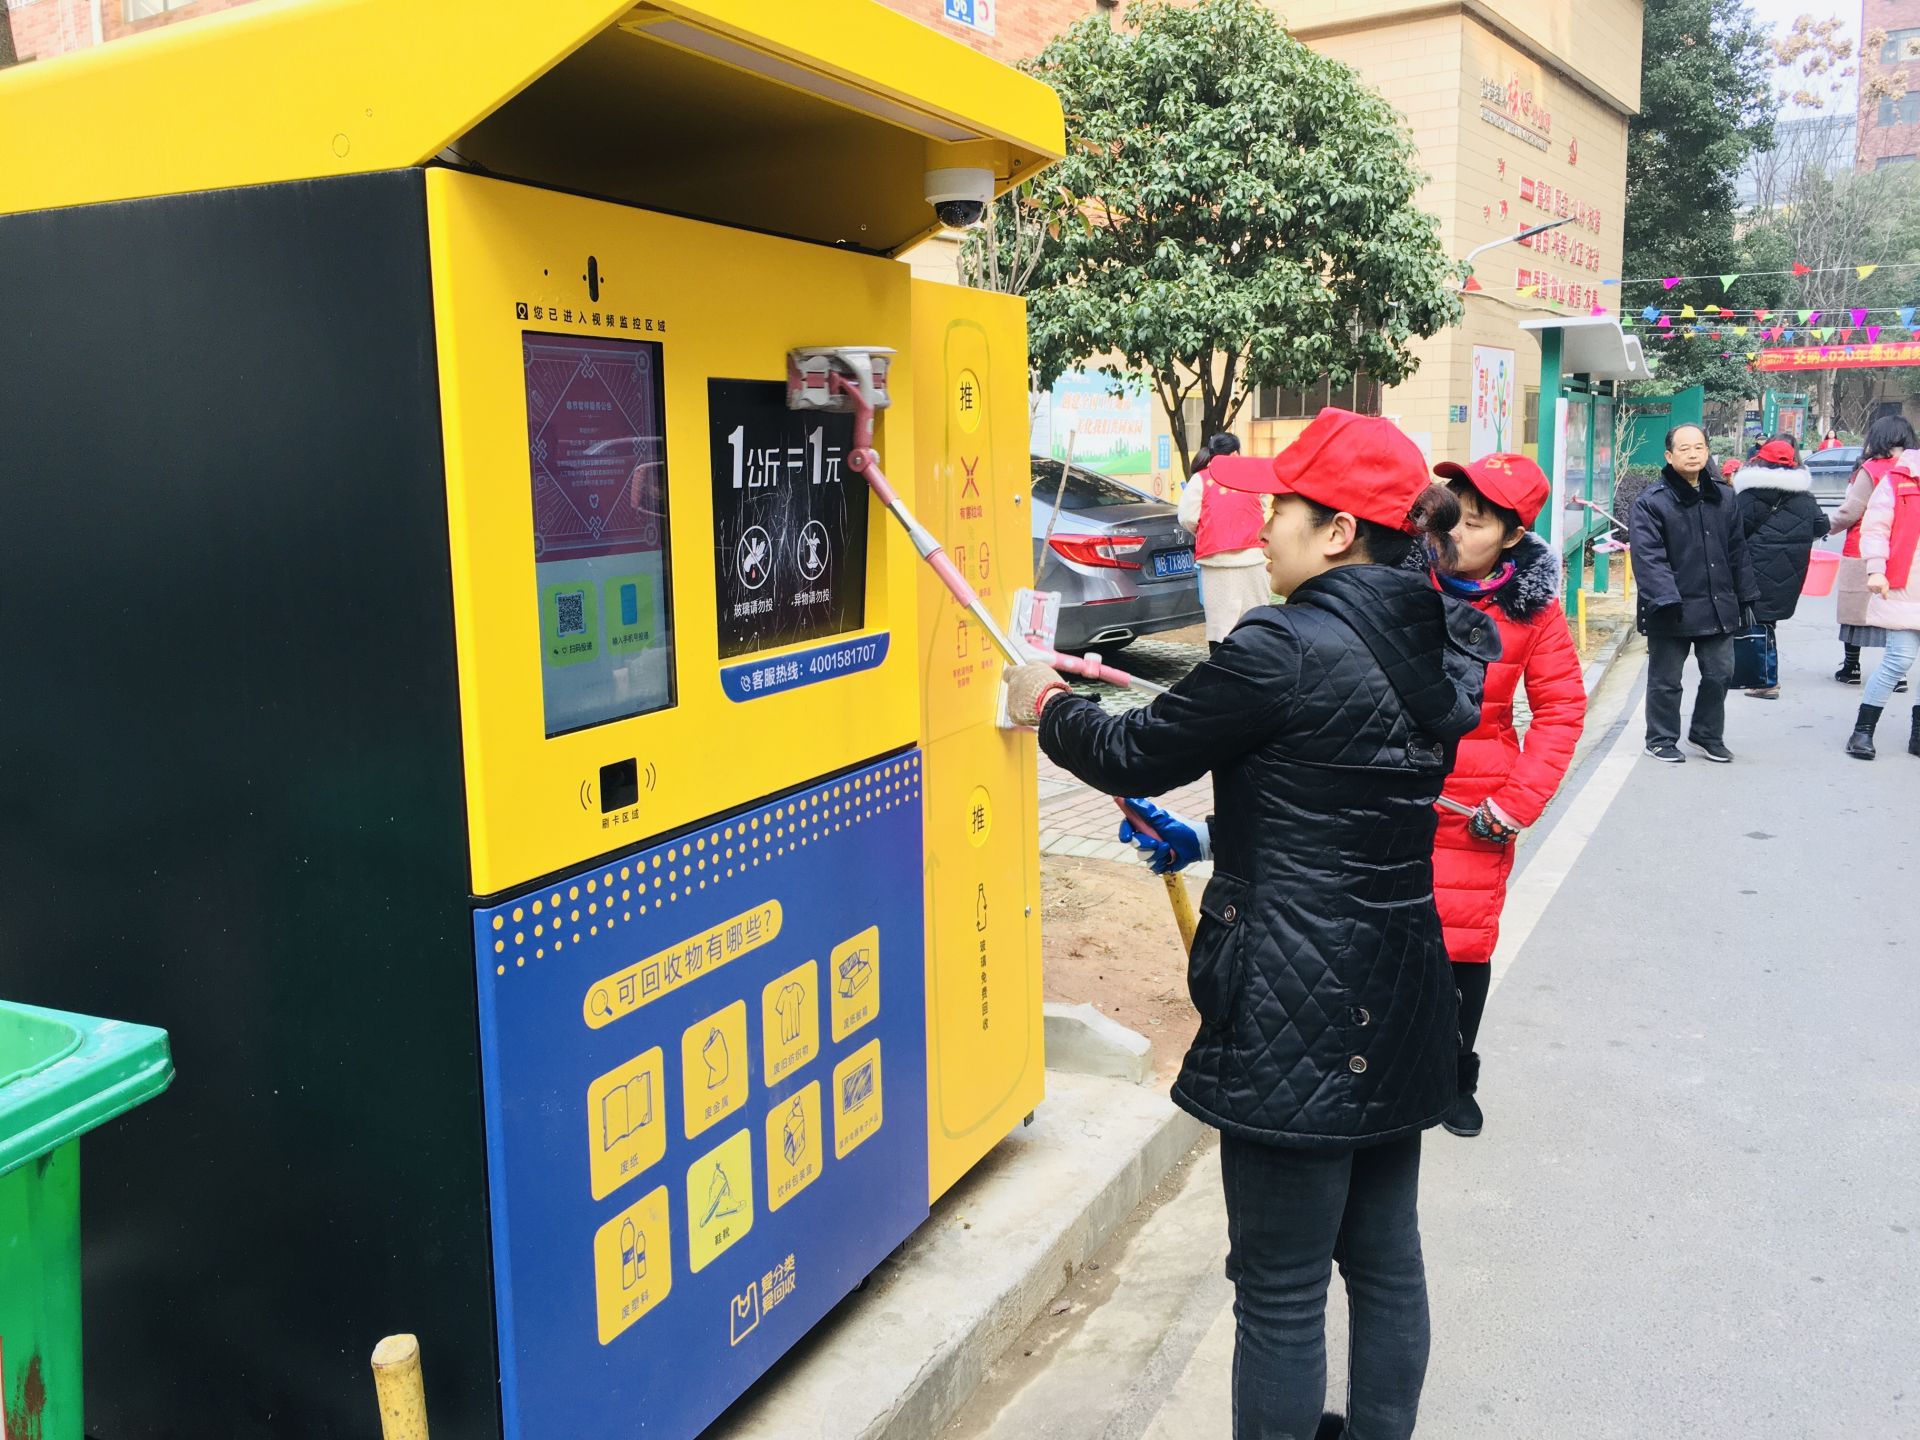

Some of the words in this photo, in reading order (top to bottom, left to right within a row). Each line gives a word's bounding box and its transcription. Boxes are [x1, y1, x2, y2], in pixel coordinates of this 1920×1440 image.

[533, 306, 666, 333] 您已进入视频监控区域
[959, 381, 974, 412] 推
[734, 598, 774, 617] 玻璃请勿投
[793, 588, 830, 607] 异物请勿投
[602, 809, 640, 829] 刷卡区域
[972, 805, 985, 834] 推
[979, 939, 990, 1031] 玻璃免费回收
[620, 1153, 639, 1175] 废纸
[761, 1252, 796, 1296] 爱分类
[761, 1272, 797, 1316] 爱回收
